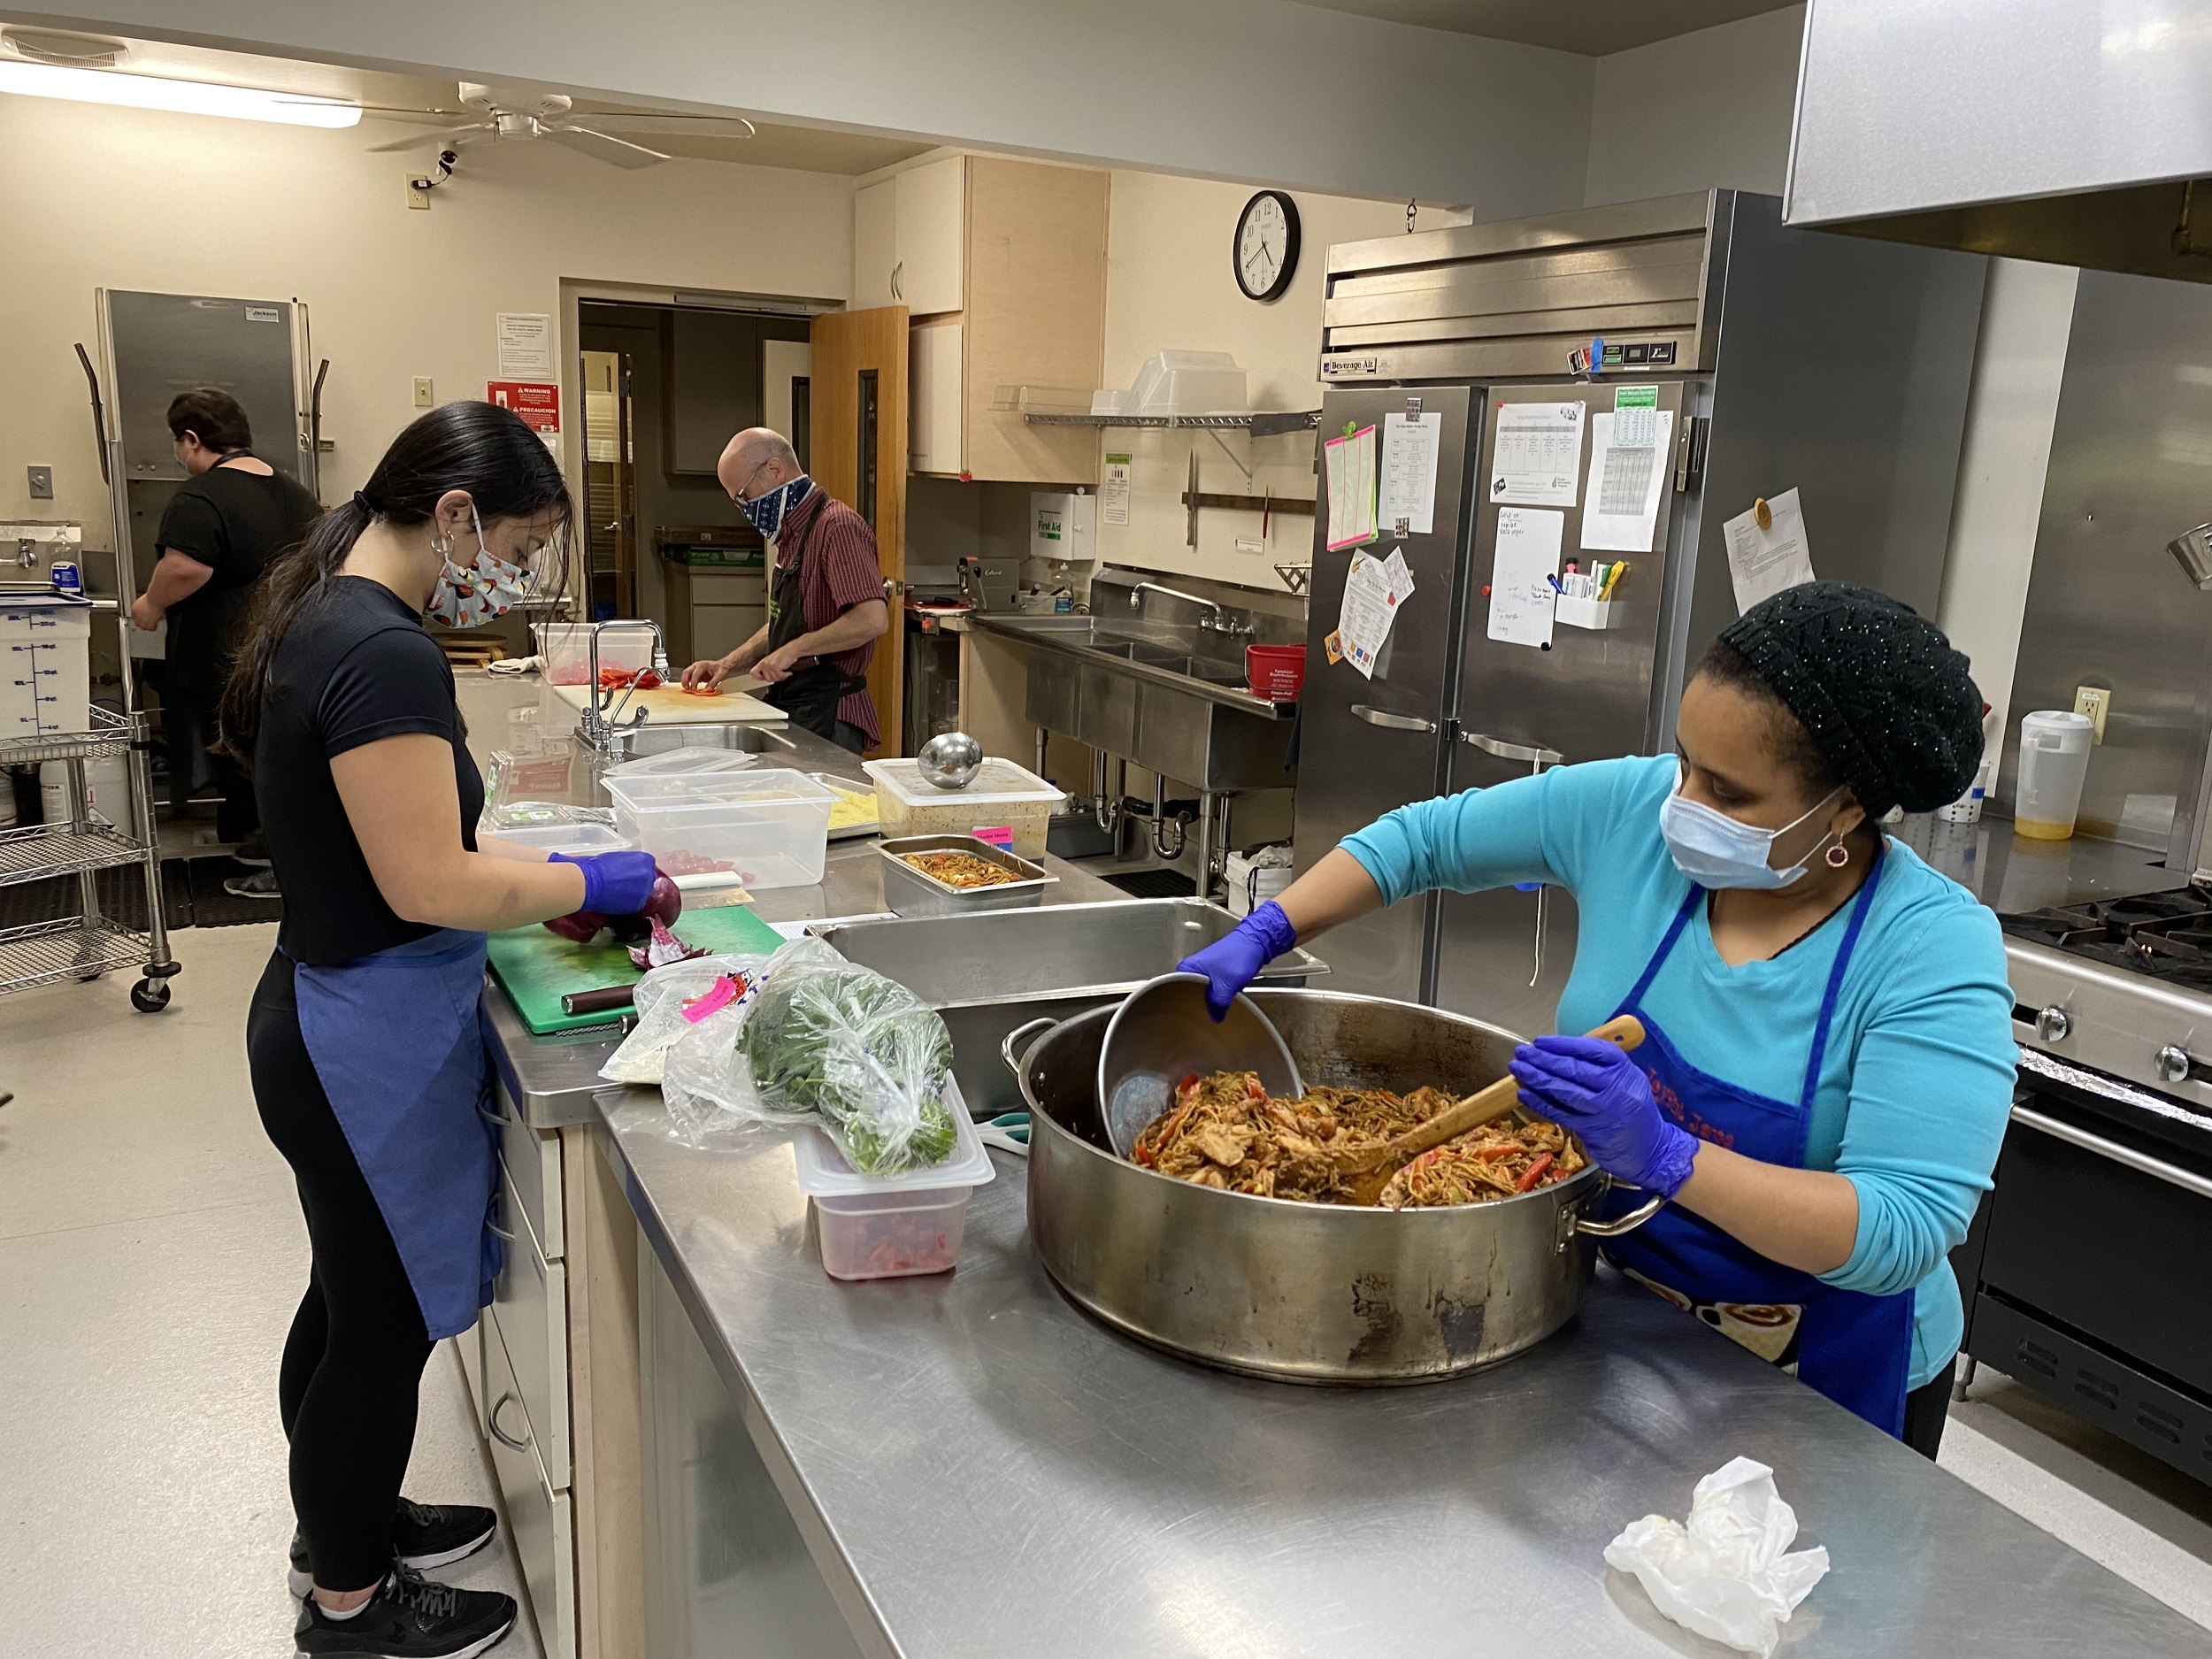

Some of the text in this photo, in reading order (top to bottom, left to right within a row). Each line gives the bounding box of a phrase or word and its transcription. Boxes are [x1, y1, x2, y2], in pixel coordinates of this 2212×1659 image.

[1263, 203, 1271, 215] 12
[1275, 206, 1279, 219] 1
[1256, 209, 1261, 222] 11
[1247, 225, 1254, 237] 10
[1243, 243, 1248, 256] 9
[1251, 273, 1256, 285] 7
[1260, 276, 1265, 288] 6
[1038, 520, 1061, 532] First Aid
